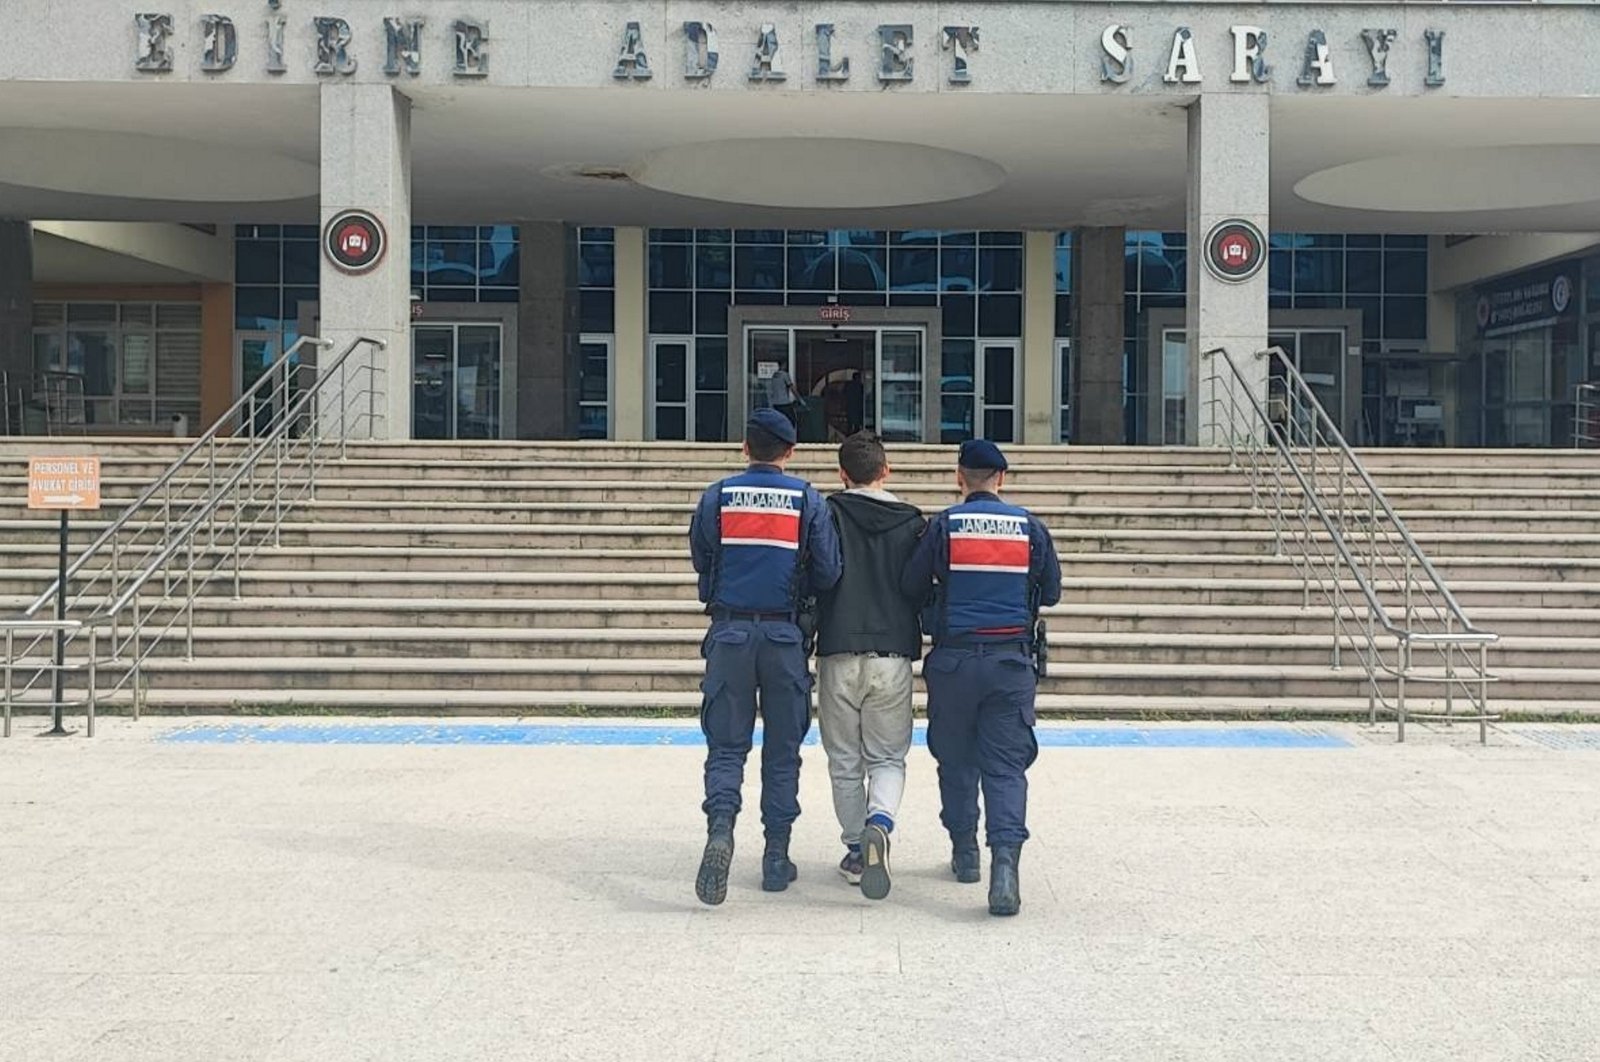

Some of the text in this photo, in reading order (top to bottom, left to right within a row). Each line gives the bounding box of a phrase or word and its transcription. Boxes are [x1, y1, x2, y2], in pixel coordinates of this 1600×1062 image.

[134, 0, 1446, 86] EDİRNE ADALET SARAYI
[820, 306, 851, 321] GİRİŞ
[34, 462, 78, 474] PERSONEL
[728, 491, 794, 510] JANDARMA
[958, 518, 1023, 536] JANDARMA
